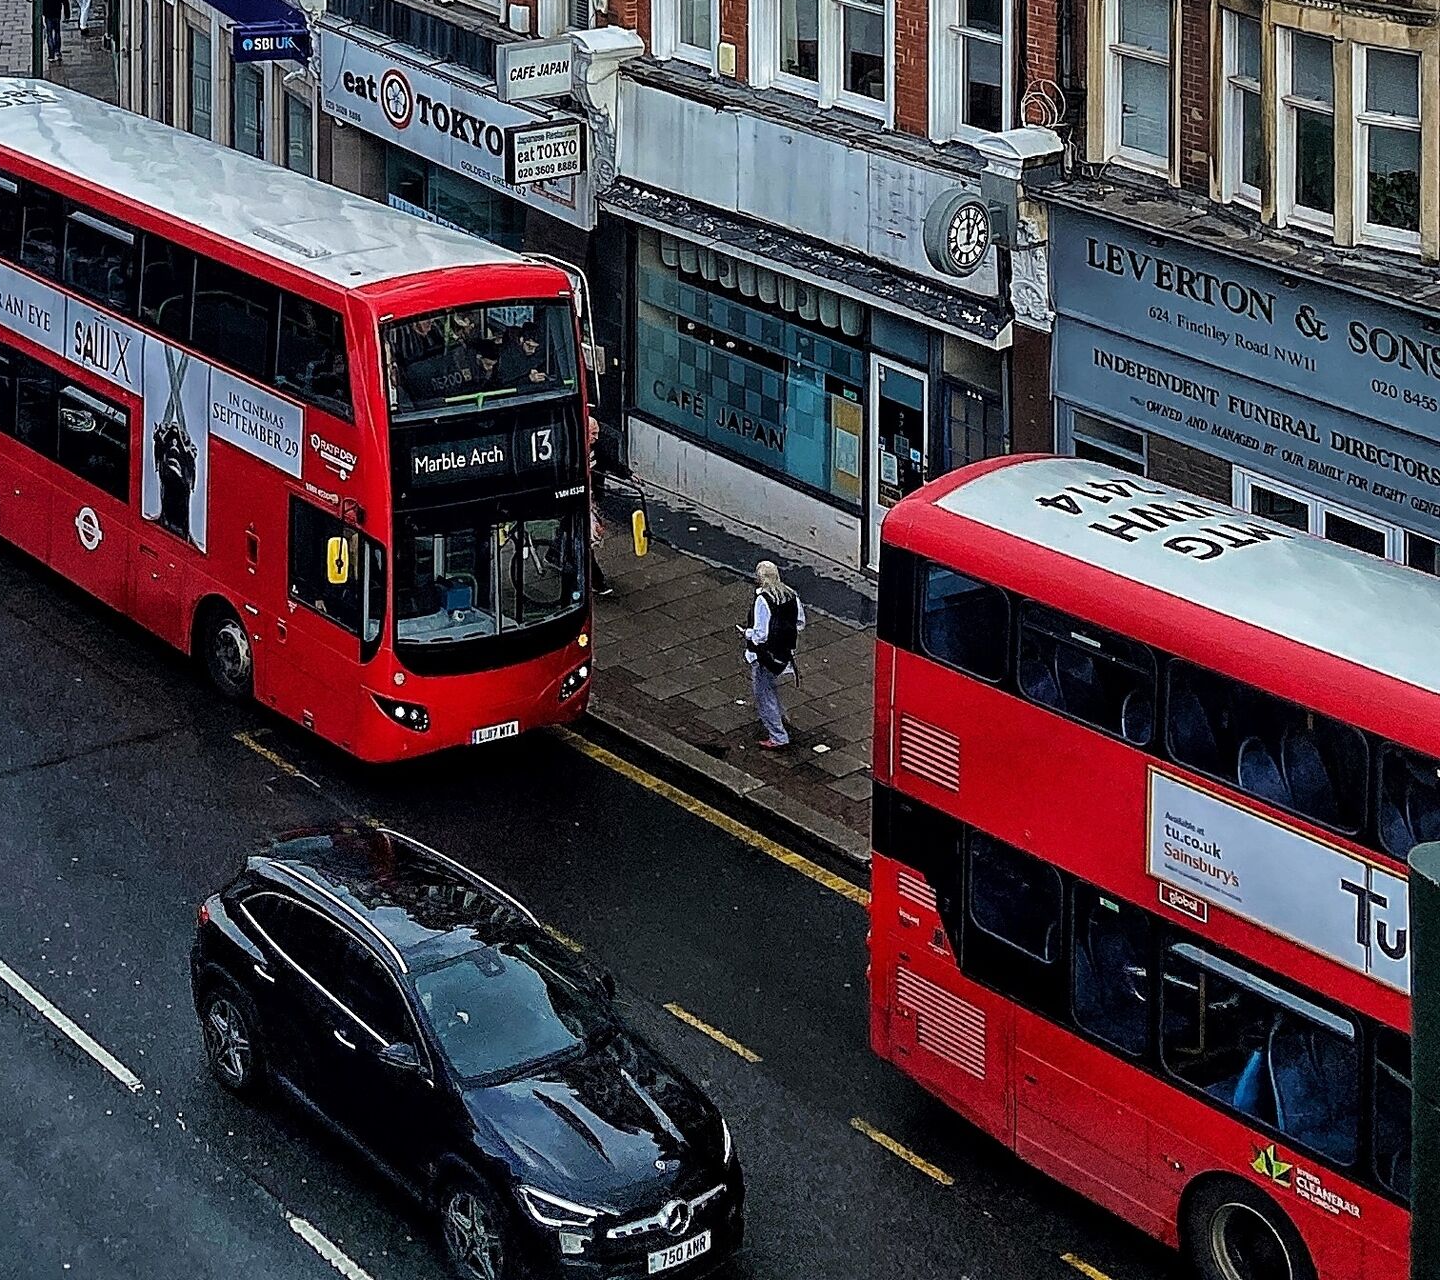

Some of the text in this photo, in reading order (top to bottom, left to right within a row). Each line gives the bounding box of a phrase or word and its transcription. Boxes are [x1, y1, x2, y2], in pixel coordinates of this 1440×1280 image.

[254, 36, 293, 51] SBI UK
[342, 70, 378, 102] eat
[509, 59, 570, 82] CAFÉ JAPAN
[415, 92, 505, 157] TOKYO
[517, 139, 577, 163] eat TOKYO
[460, 160, 491, 181] GOLDERS
[517, 167, 533, 179] 020
[534, 164, 555, 176] 3609
[5, 293, 24, 319] AN
[28, 303, 51, 333] EYE
[1085, 236, 1440, 381] LEVERTON & SONS
[74, 320, 132, 384] SAW X
[1176, 313, 1230, 347] Finchley
[1234, 331, 1269, 358] Road
[1273, 344, 1318, 373] NW11
[228, 391, 285, 430] IN CINEMAS
[1371, 378, 1438, 413] 020 8455
[212, 402, 299, 458] SEPTEMBER 29
[653, 379, 784, 454] CAFÉ JAPAN
[1092, 347, 1440, 486] INDEPENDENT FUNERAL DIRECTORS
[414, 445, 504, 475] Marble Arch
[531, 428, 553, 463] 13
[1146, 400, 1183, 423] OWNED
[1185, 415, 1209, 432] AND
[1211, 423, 1260, 451] MANAGED
[1263, 441, 1278, 457] BY
[1281, 449, 1305, 468] OUR
[1308, 458, 1345, 482] FAMILY
[1346, 472, 1369, 491] FOR
[1372, 482, 1408, 504] EIGHT
[1162, 522, 1296, 561] MTG
[1164, 811, 1205, 837] Available at
[1164, 823, 1222, 860] tu.co.uk
[1164, 841, 1240, 888] Sainsbury's
[1168, 890, 1199, 913] global
[1340, 878, 1407, 960] Tu
[661, 1247, 683, 1268] 750
